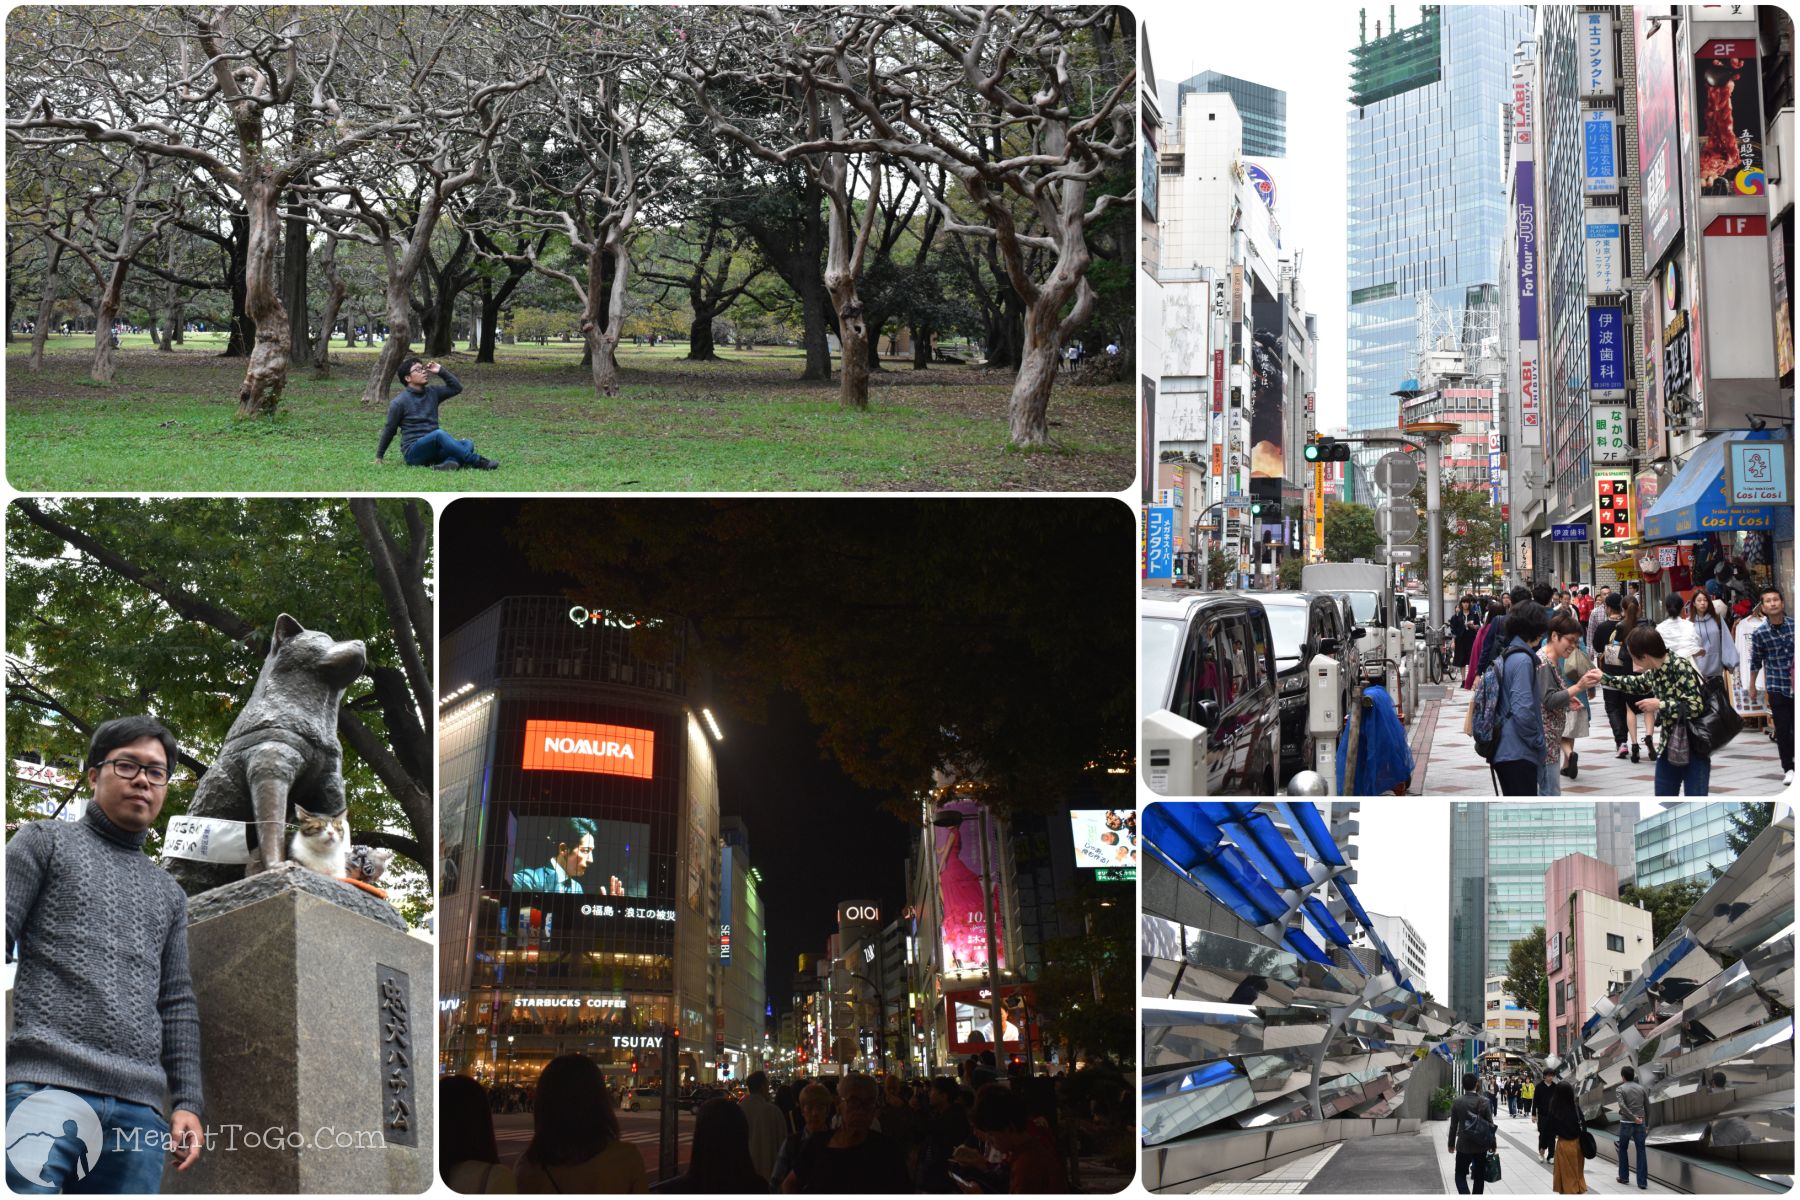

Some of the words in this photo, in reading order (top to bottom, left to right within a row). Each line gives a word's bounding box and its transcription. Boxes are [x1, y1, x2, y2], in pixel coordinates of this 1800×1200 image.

[1589, 15, 1602, 88] 富士コンタクト
[1714, 44, 1735, 55] 2F
[1516, 84, 1525, 127] LABI
[1592, 111, 1604, 120] 3F
[1588, 123, 1599, 176] クリニック
[1726, 218, 1747, 233] 1F
[1599, 313, 1614, 379] 伊波歯科
[1522, 361, 1533, 408] LABI
[1602, 390, 1613, 398] 4F
[1596, 420, 1607, 447] 眼科
[1611, 410, 1623, 448] なかの
[1603, 452, 1618, 460] 7F
[1600, 483, 1612, 535] ブラウン
[1615, 483, 1626, 535] ブラック
[1150, 513, 1161, 573] コンタクト
[1163, 519, 1171, 565] メガネスーパー
[544, 736, 635, 760] NOMURA
[720, 924, 731, 959] SEIBU
[514, 998, 581, 1008] STARBUCKS
[586, 998, 627, 1009] COFFEE
[382, 978, 410, 1132] 忠犬ハチ公
[612, 1036, 664, 1049] TSUTAY
